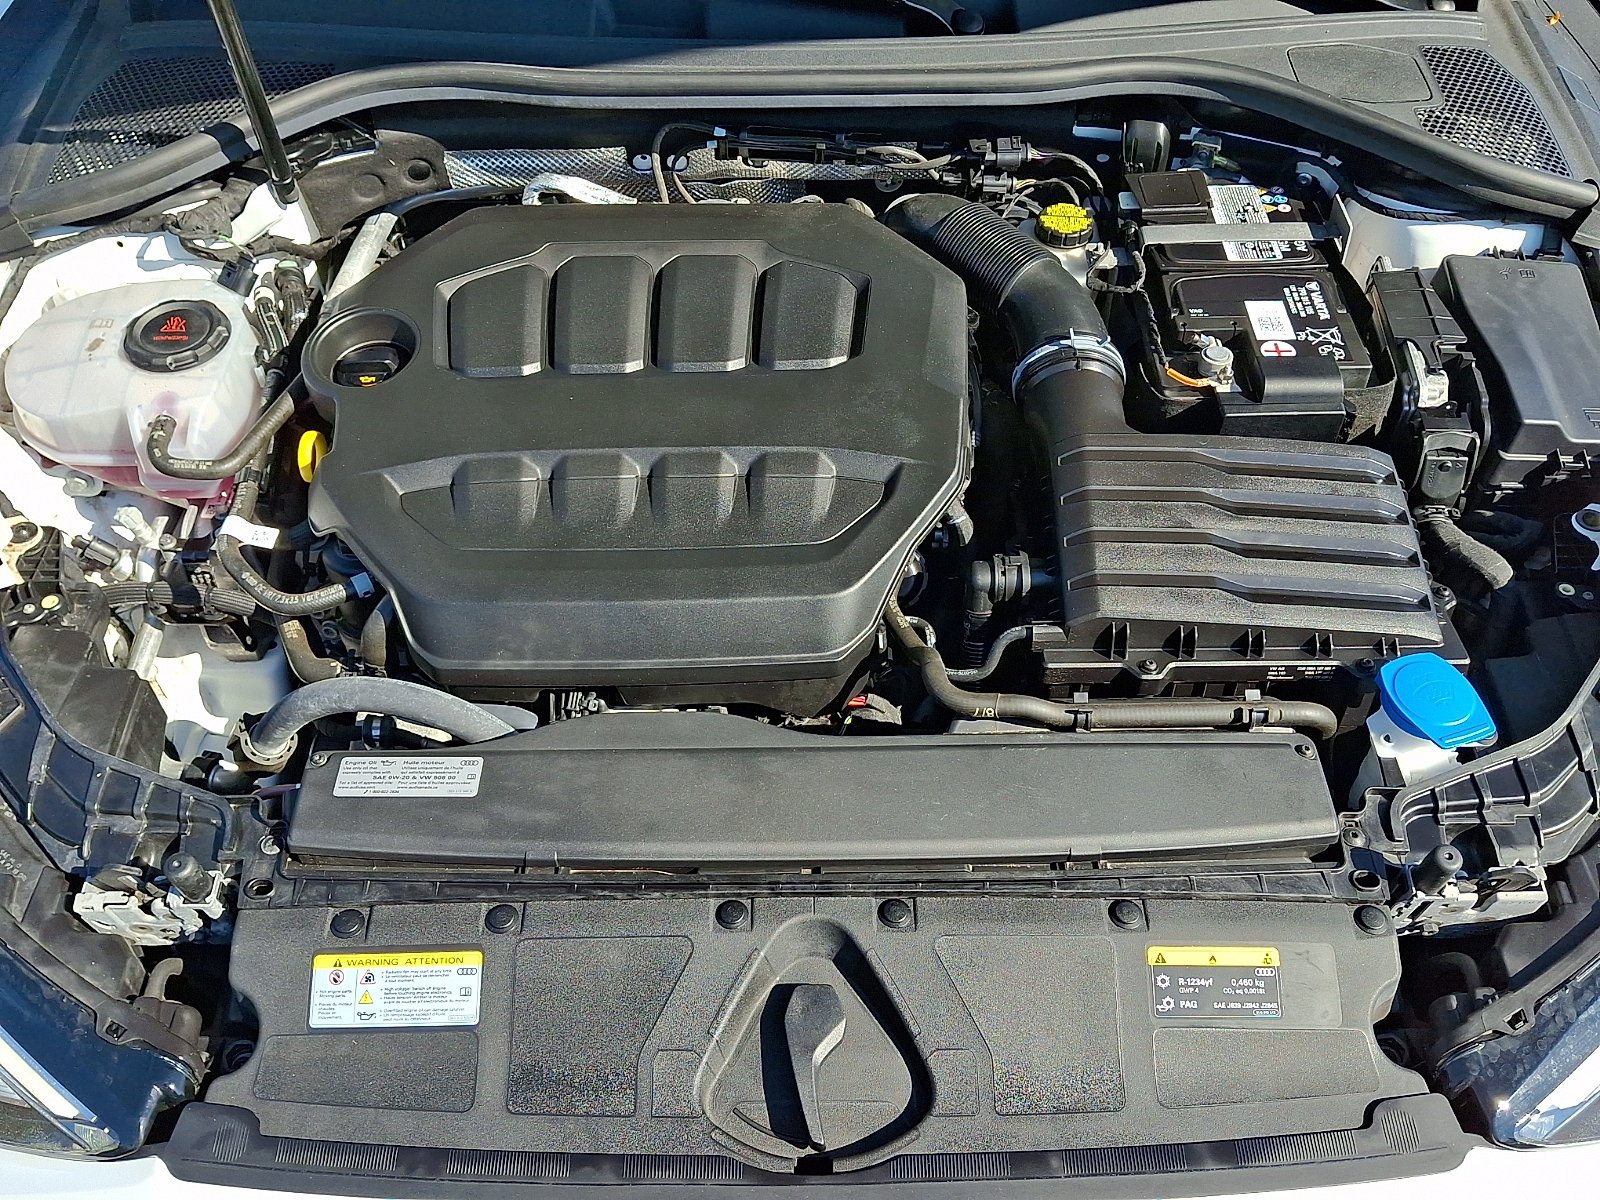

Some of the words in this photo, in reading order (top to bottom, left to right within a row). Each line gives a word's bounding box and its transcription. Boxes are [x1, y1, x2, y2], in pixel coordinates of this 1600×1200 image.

[1310, 291, 1331, 320] VARTA
[347, 958, 398, 966] WARNING
[405, 957, 464, 965] ATTENTION
[1178, 977, 1213, 988] R-1234yf
[1231, 978, 1253, 987] 0,460
[1255, 978, 1264, 988] kg
[1180, 1000, 1197, 1009] PAG
[1213, 1001, 1226, 1009] SAE
